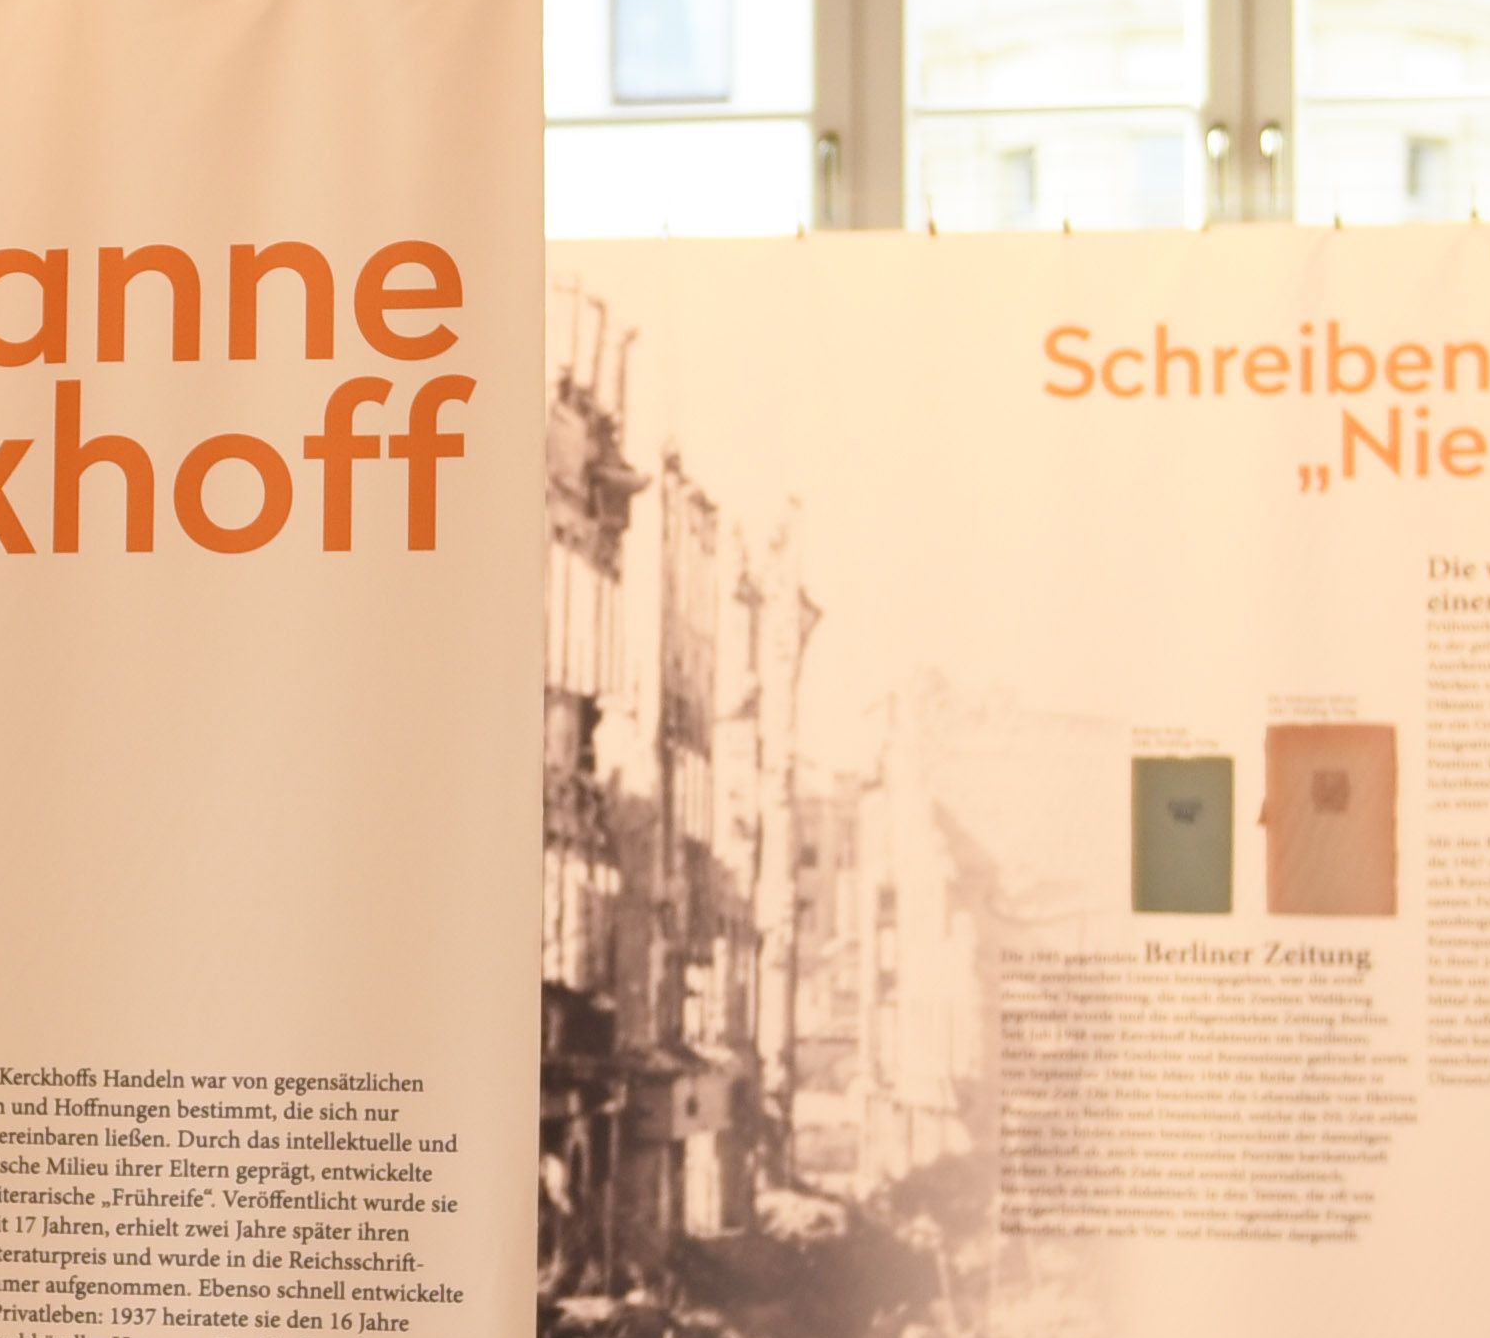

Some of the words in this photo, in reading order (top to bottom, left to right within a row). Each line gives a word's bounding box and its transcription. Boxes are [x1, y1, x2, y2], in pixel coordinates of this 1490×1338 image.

[1043, 319, 1490, 400] Schreiben
[1298, 405, 1488, 493] „Nie
[1427, 556, 1475, 580] Die
[1146, 941, 1253, 964] Berliner
[1266, 941, 1373, 972] Zeitung
[0, 1067, 97, 1087] Kerckhoffs
[103, 1069, 184, 1088] Handeln
[191, 1076, 227, 1089] war
[232, 1077, 267, 1089] von
[274, 1072, 423, 1096] gegensätzlichen
[12, 1097, 48, 1115] und
[55, 1097, 170, 1123] Hoffnungen
[177, 1099, 277, 1122] bestimmt,
[284, 1101, 313, 1120] die
[320, 1102, 357, 1120] sich
[365, 1109, 399, 1121] nur
[105, 1128, 170, 1147] ließen.
[178, 1130, 240, 1148] Durch
[247, 1130, 280, 1149] das
[287, 1131, 412, 1152] intellektuelle
[419, 1134, 457, 1152] und
[46, 1157, 108, 1176] Milieu
[116, 1158, 163, 1177] ihrer
[170, 1159, 229, 1178] Eltern
[236, 1162, 315, 1185] geprägt,
[322, 1162, 432, 1182] entwickelte
